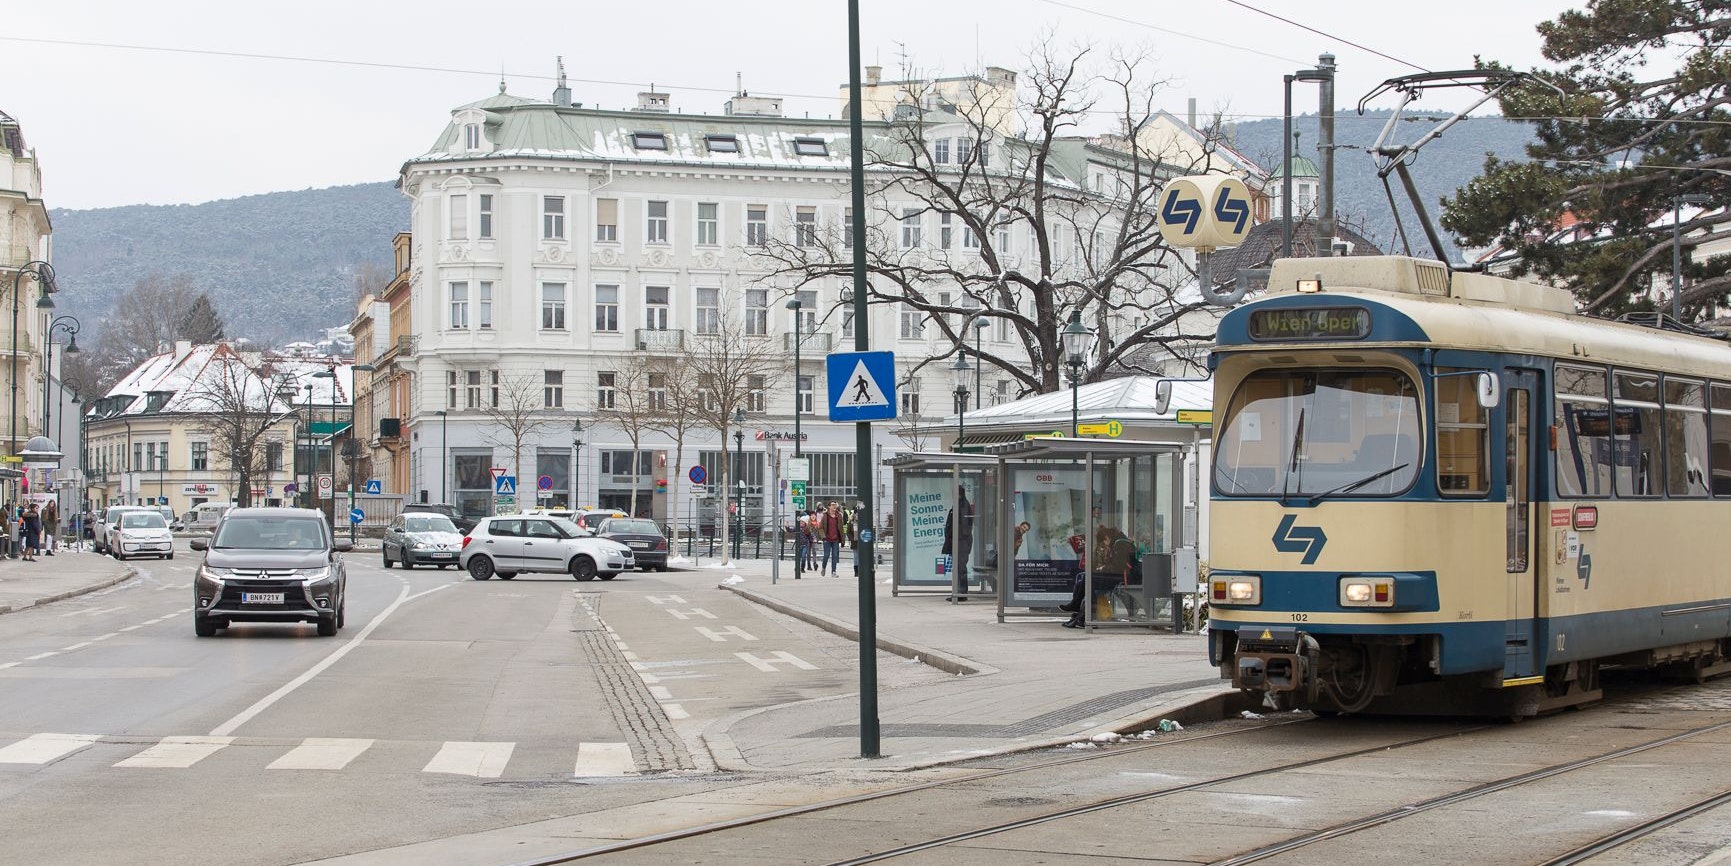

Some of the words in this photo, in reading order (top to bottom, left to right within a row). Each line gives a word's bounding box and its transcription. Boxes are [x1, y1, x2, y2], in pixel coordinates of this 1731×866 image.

[1267, 312, 1311, 331] Wien
[1109, 424, 1118, 434] H
[764, 431, 782, 440] Bank
[909, 492, 942, 504] Meine
[911, 504, 947, 515] Sonne.
[912, 515, 944, 526] Meine
[913, 527, 946, 538] Energ
[1291, 614, 1308, 622] 102
